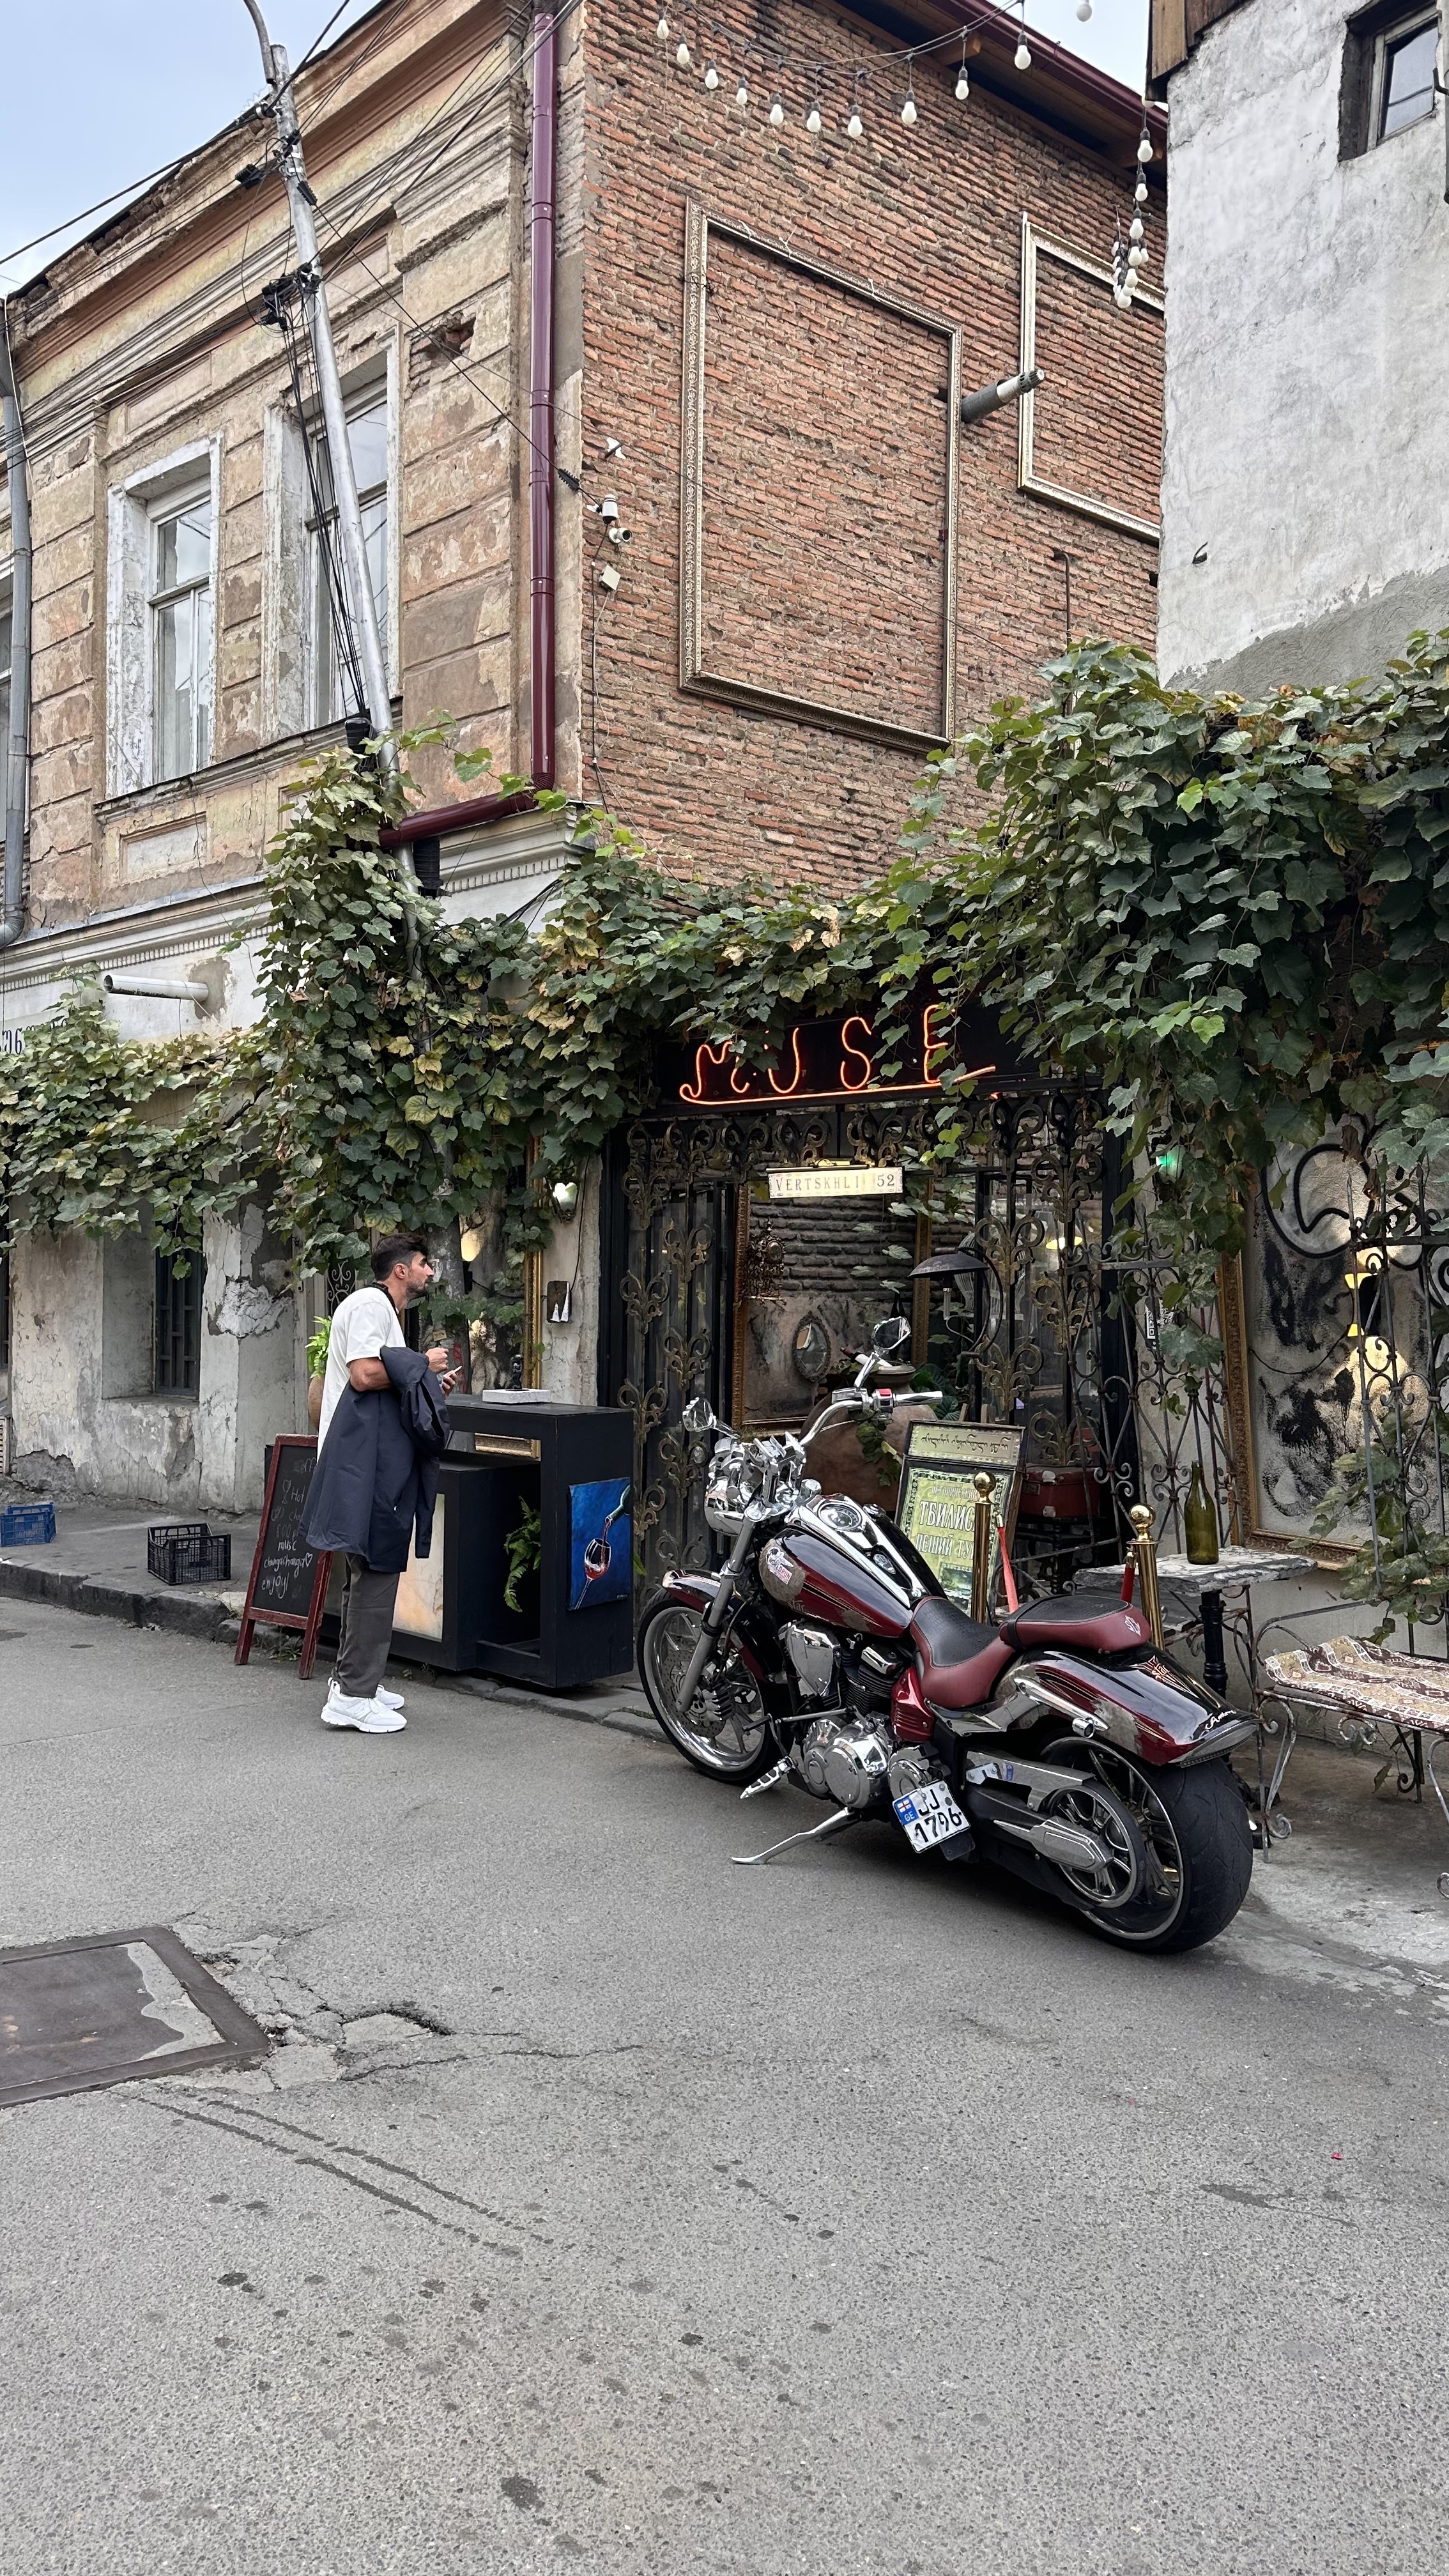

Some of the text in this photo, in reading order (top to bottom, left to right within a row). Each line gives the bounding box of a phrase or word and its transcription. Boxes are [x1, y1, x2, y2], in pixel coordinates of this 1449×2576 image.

[680, 1005, 958, 1099] MUSE
[776, 1174, 894, 1191] VERTSKHLI 52
[291, 1485, 306, 1503] Hot
[919, 1499, 975, 1532] ТБИЛИС
[916, 1533, 974, 1561] ПЕШИЙ ТУ
[904, 1811, 915, 1821] GE
[918, 1789, 940, 1816] JJ
[914, 1807, 962, 1843] 1796
